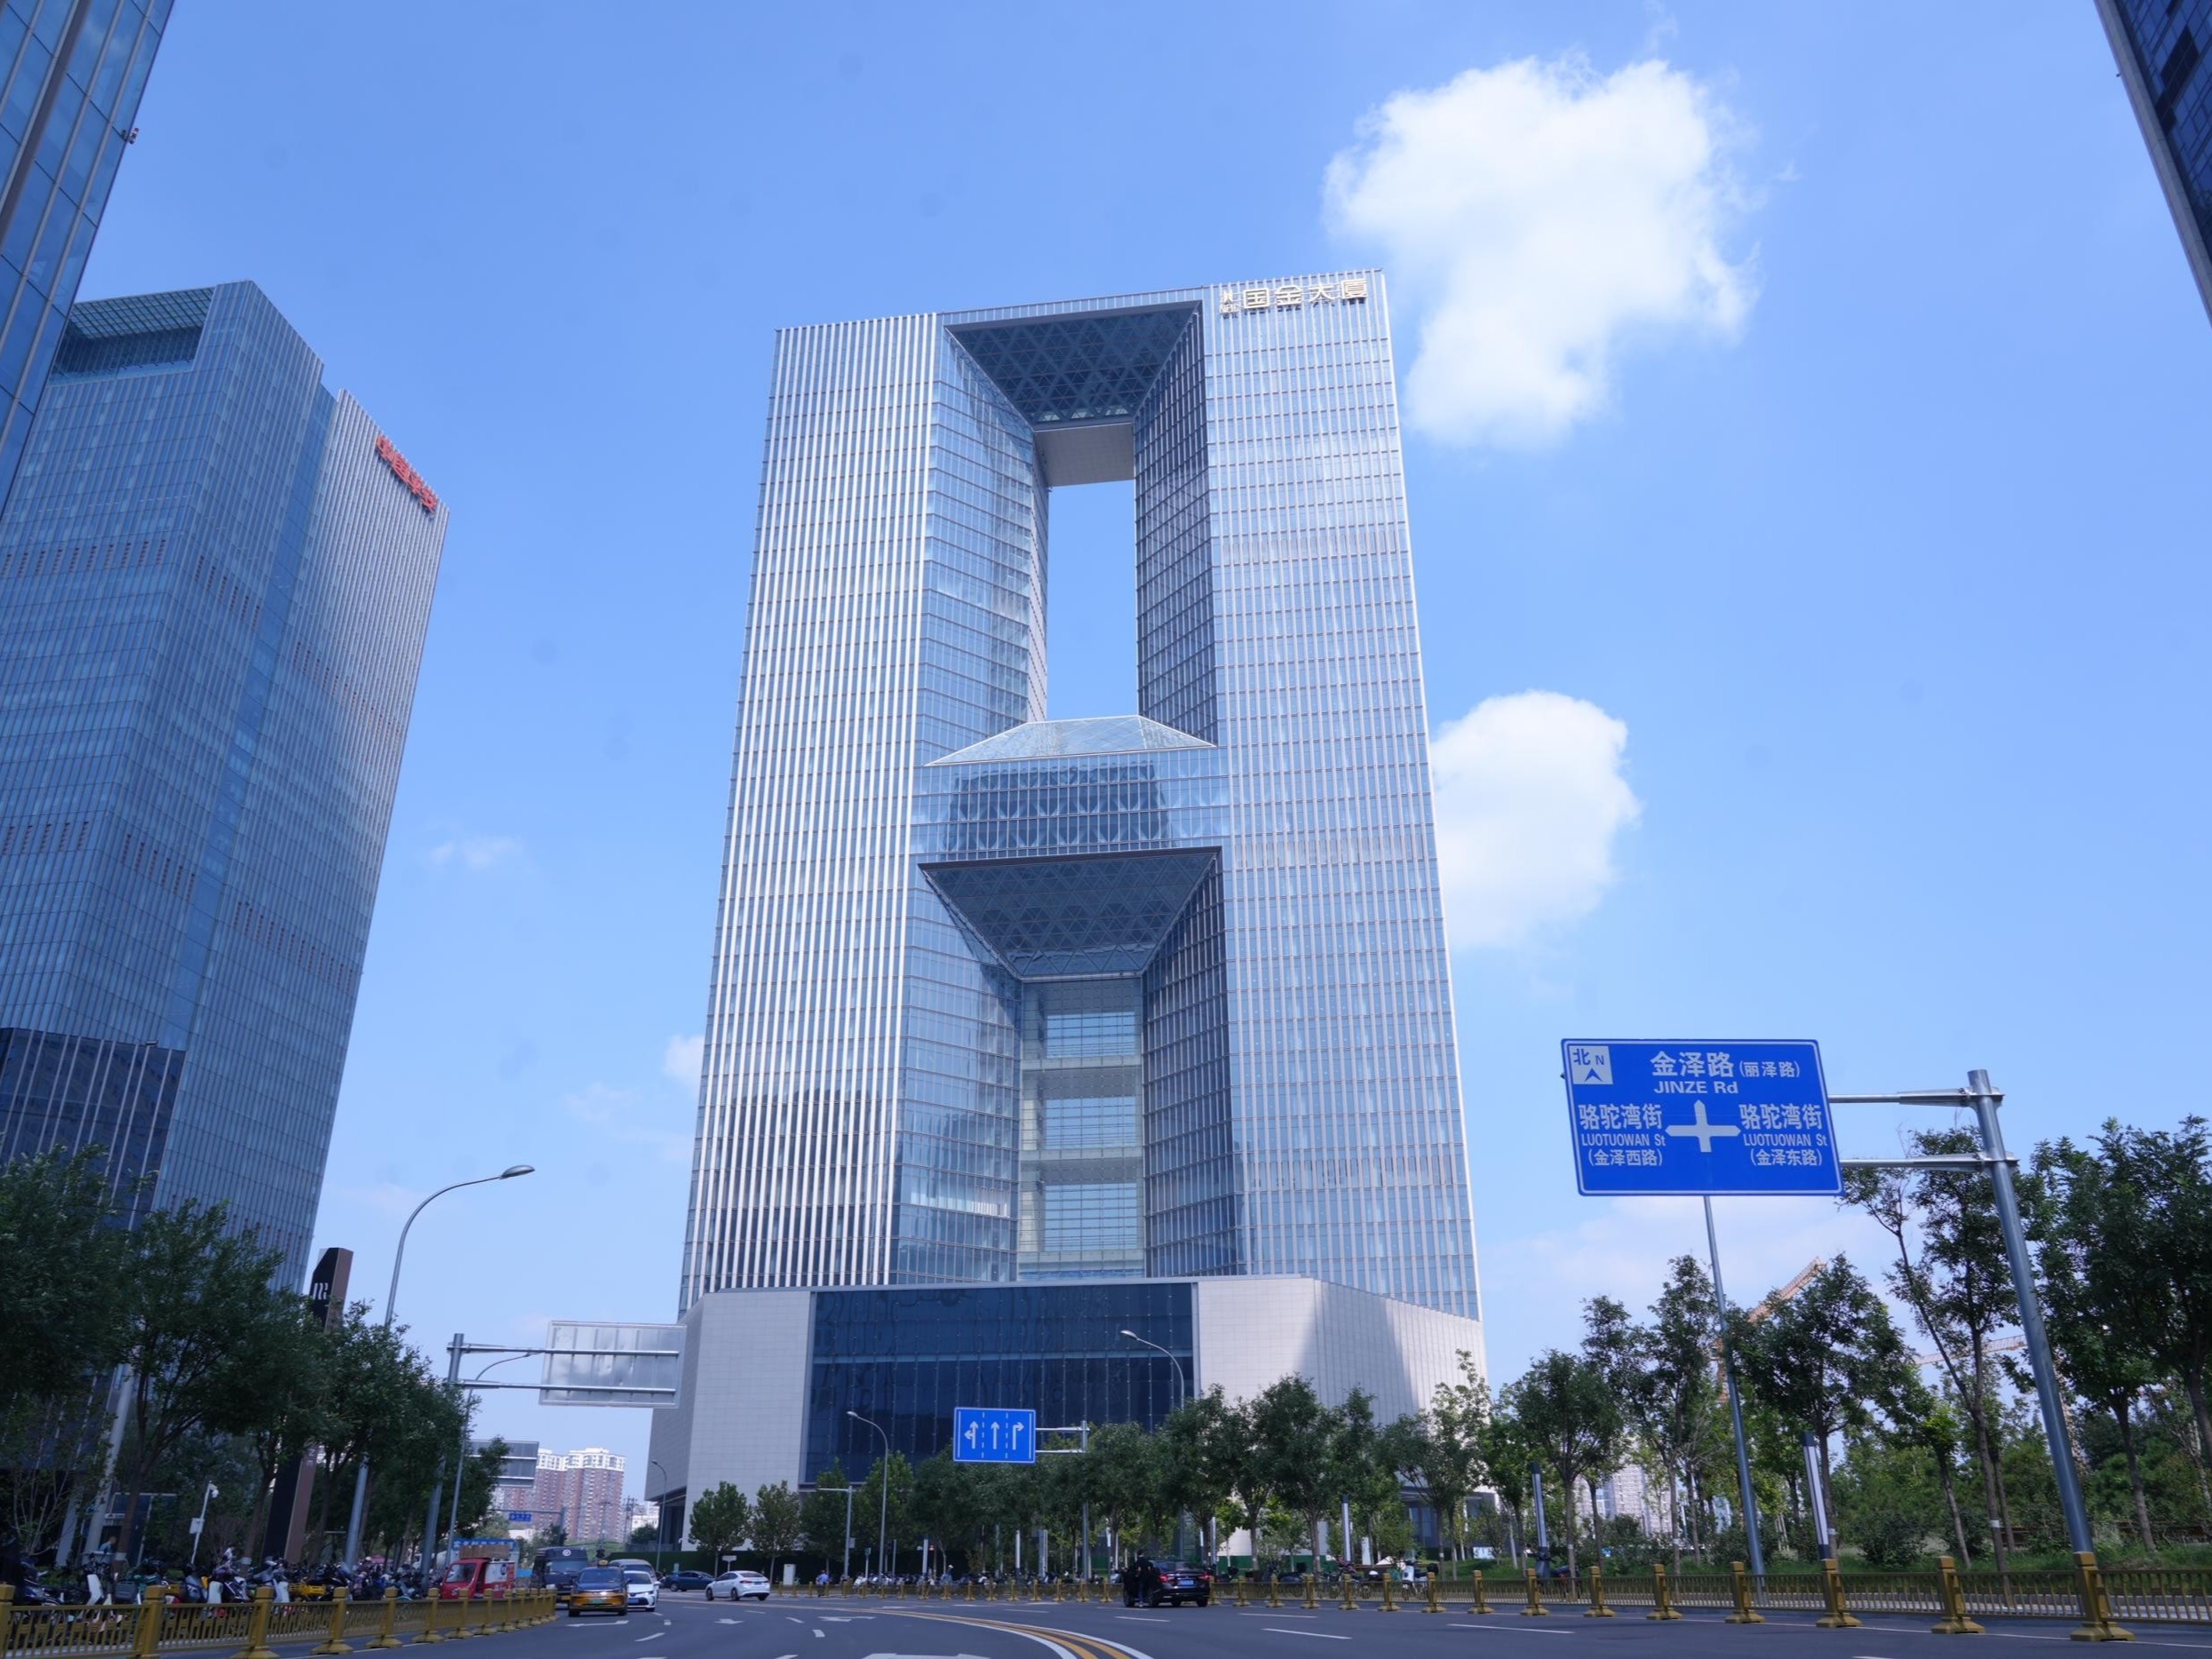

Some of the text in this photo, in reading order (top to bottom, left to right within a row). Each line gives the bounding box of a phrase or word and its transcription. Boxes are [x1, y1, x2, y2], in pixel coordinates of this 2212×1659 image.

[1244, 278, 1367, 309] 国金大厦
[1572, 1048, 1604, 1066] 北 N
[1651, 1052, 1800, 1077] 金泽路 (丽泽路)
[1654, 1081, 1739, 1093] JINZE Rd
[1579, 1104, 1662, 1130] 骆驼湾街
[1739, 1104, 1822, 1130] 骆驼湾街
[1581, 1133, 1667, 1147] LUOTUOWAN St
[1743, 1133, 1827, 1147] LUOTUOWAN St
[1588, 1149, 1662, 1166] (金泽西路)
[1751, 1148, 1822, 1166] (金泽东路)
